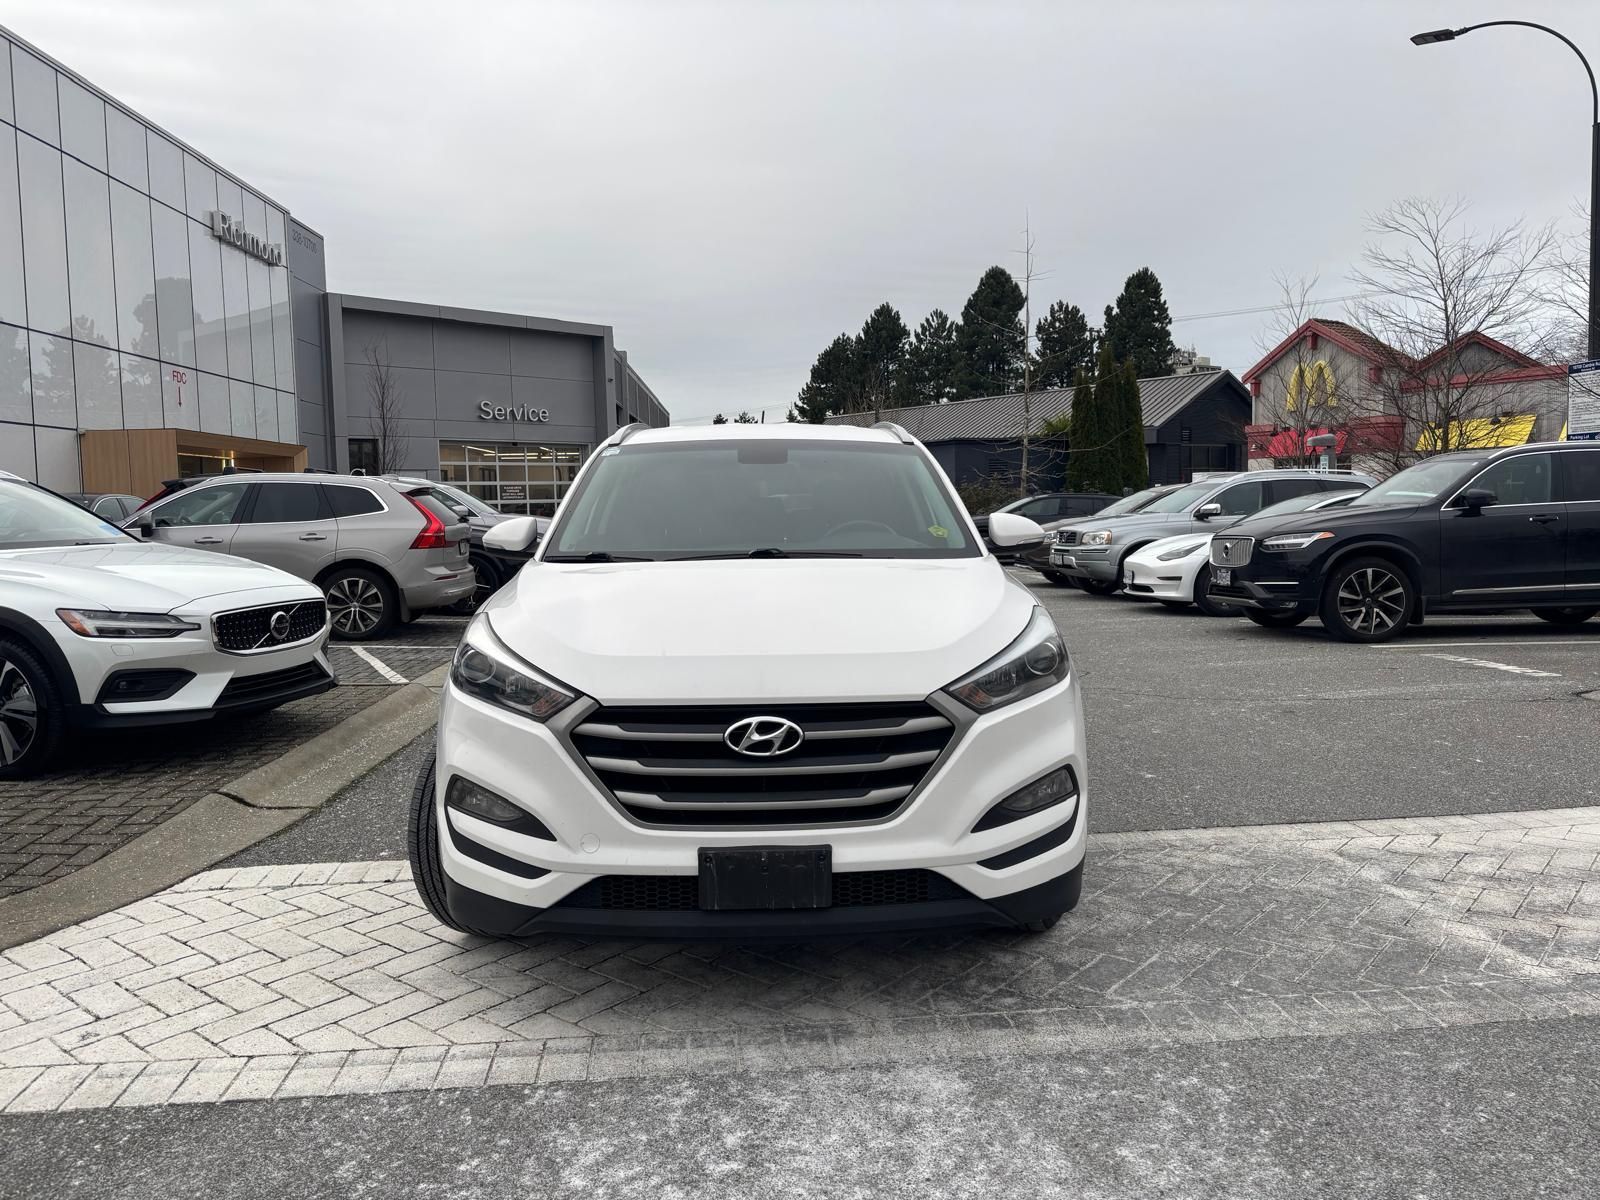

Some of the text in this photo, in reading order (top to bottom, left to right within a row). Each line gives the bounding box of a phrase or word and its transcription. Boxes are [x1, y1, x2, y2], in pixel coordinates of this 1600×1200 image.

[212, 210, 282, 267] Richmond
[172, 370, 187, 385] FDC
[480, 400, 550, 422] Service
